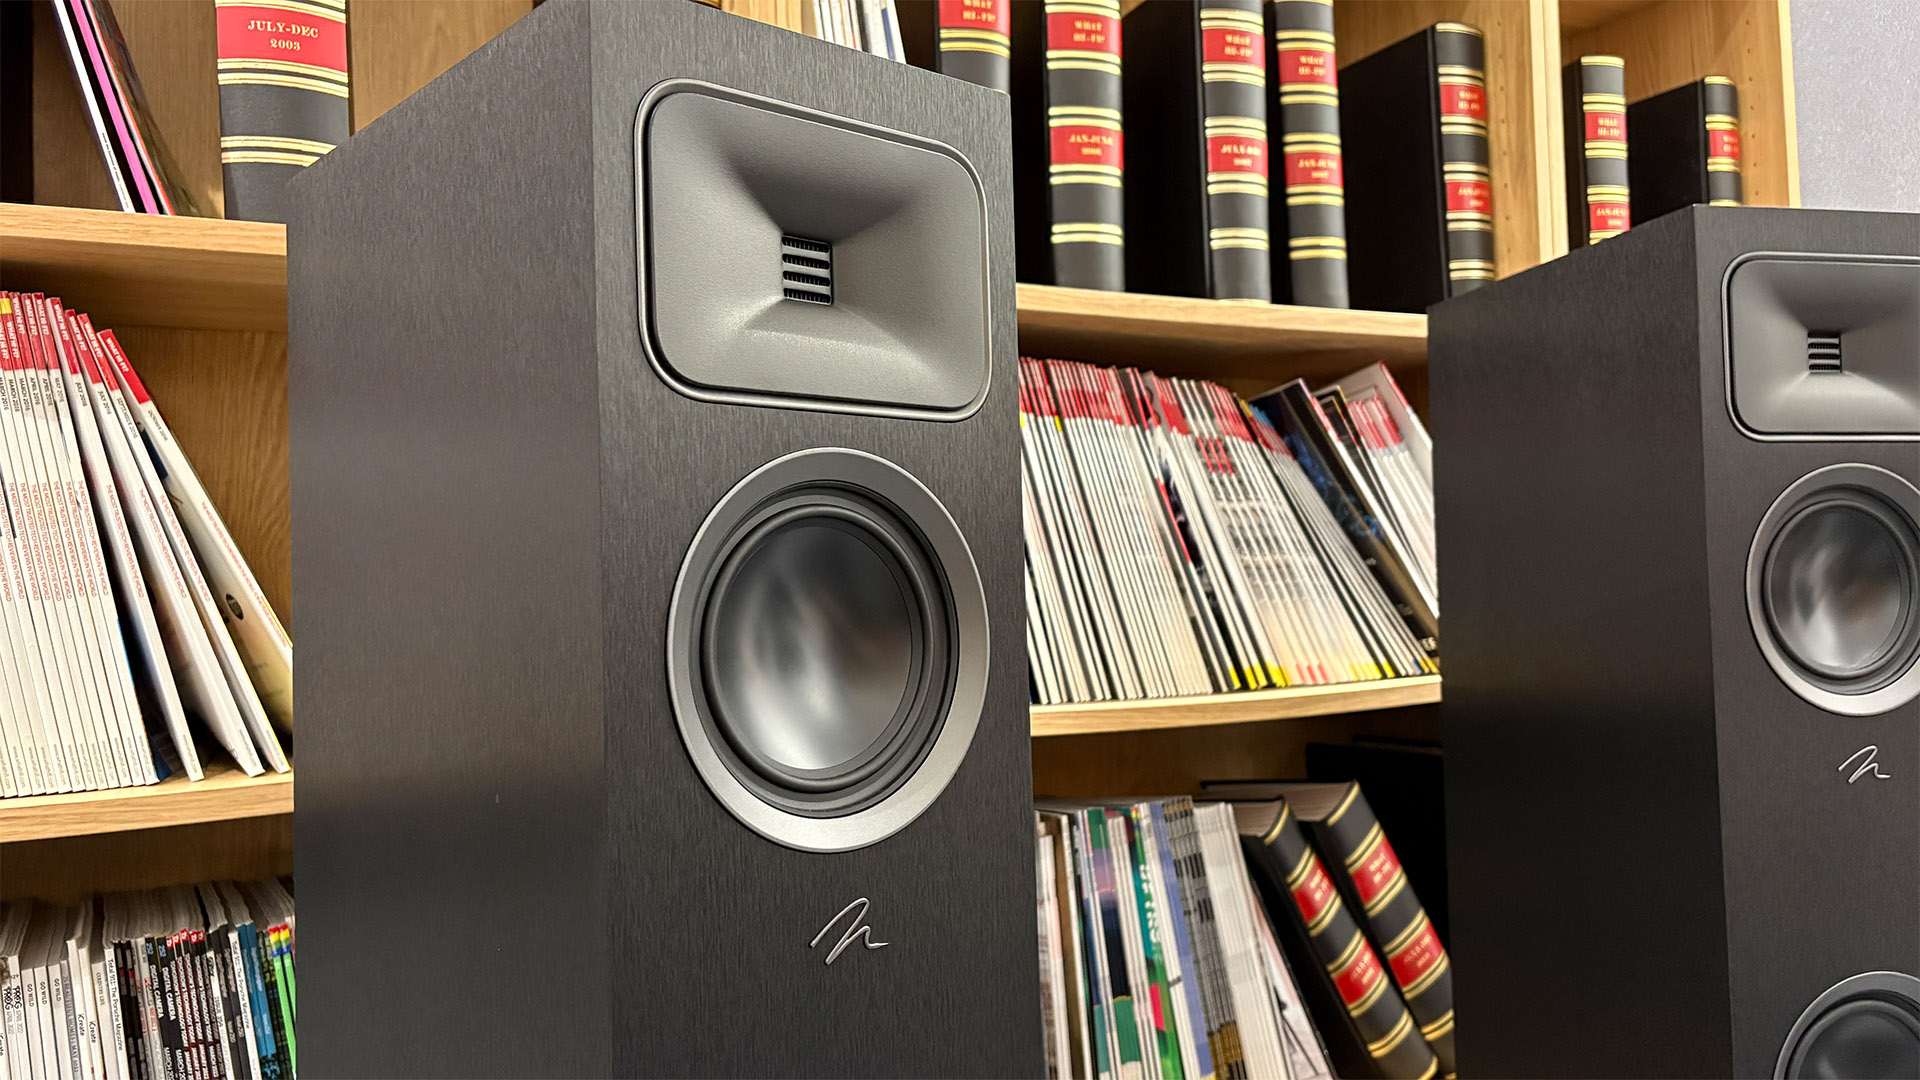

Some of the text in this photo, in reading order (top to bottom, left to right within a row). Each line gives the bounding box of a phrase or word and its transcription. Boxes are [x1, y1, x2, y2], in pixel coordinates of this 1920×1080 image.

[248, 20, 318, 38] JULY-DEC
[270, 38, 301, 51] 2003
[13, 296, 22, 316] WHAT
[25, 299, 34, 318] WHAT
[37, 299, 46, 317] WHAT
[54, 303, 64, 322] WHAT
[6, 321, 16, 340] WHAT
[69, 315, 81, 334] WHAT
[84, 322, 96, 340] WHAT
[106, 337, 120, 355] WHAT
[9, 378, 17, 398] MARCH
[19, 378, 28, 398] MARCH
[30, 377, 38, 393] APRIL
[42, 378, 50, 394] APRIL
[75, 382, 84, 394] JULY
[98, 391, 107, 402] JULY
[11, 492, 19, 508] MOST
[22, 492, 31, 508] MOST
[34, 494, 42, 509] MOST
[44, 492, 52, 507] MOST
[56, 491, 64, 506] MOST
[14, 508, 24, 530] TRUSTED
[26, 508, 35, 530] TRUSTED
[37, 509, 46, 532] TRUSTED
[47, 507, 57, 529] TRUSTED
[59, 505, 69, 528] TRUSTED
[64, 528, 72, 541] TECH
[22, 544, 31, 565] REVIEWS
[33, 544, 43, 565] REVIEWS
[44, 545, 54, 566] REVIEWS
[55, 543, 64, 564] REVIEWS
[67, 541, 77, 562] REVIEWS
[30, 582, 39, 601] WORLD
[41, 582, 50, 601] WORLD
[52, 582, 61, 602] WORLD
[63, 580, 72, 599] WORLD
[75, 579, 84, 598] WORLD
[150, 964, 160, 989] DIGITAL
[3, 986, 13, 1010] PROG
[13, 985, 22, 1009] PROG
[63, 982, 73, 1019] BEAUTIFUL
[162, 966, 176, 1021] DIGITAL CAMERA
[111, 998, 120, 1022] Porsche
[154, 990, 164, 1019] CAMERA
[67, 1020, 75, 1042] HOMES
[114, 1023, 123, 1051] Magazine
[164, 1047, 172, 1070] MARCH
[176, 1050, 184, 1072] MARCH
